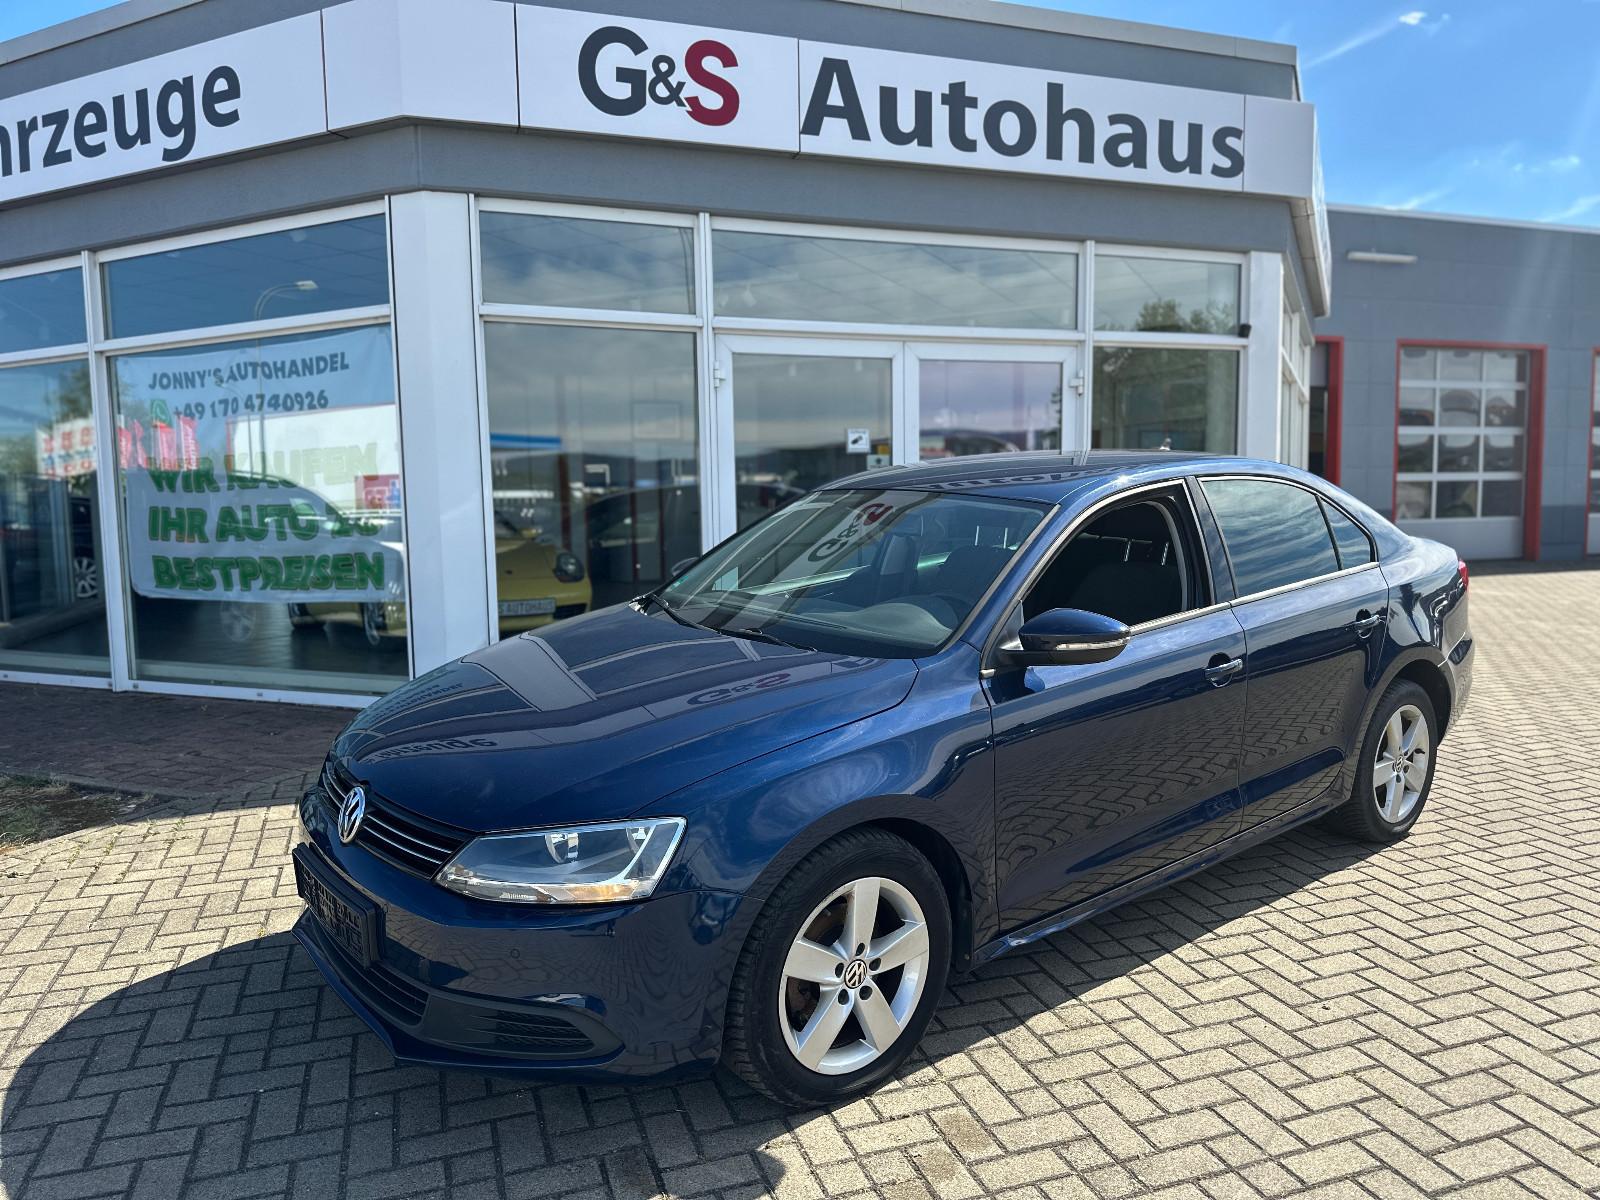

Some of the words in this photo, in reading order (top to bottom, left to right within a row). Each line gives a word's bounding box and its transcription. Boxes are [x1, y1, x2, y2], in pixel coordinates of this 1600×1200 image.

[578, 25, 740, 127] G&S
[800, 57, 1246, 179] Autohaus
[149, 367, 223, 390] JONNY'S
[225, 352, 350, 384] AUTOHANDEL
[174, 402, 205, 421] +49
[210, 396, 239, 418] 170
[244, 389, 329, 412] 4740926
[147, 456, 221, 493] WIR
[224, 442, 378, 491] KAUFEN
[149, 506, 209, 543] IHR
[216, 502, 319, 541] AUTO
[152, 552, 385, 592] BESTPREISEN
